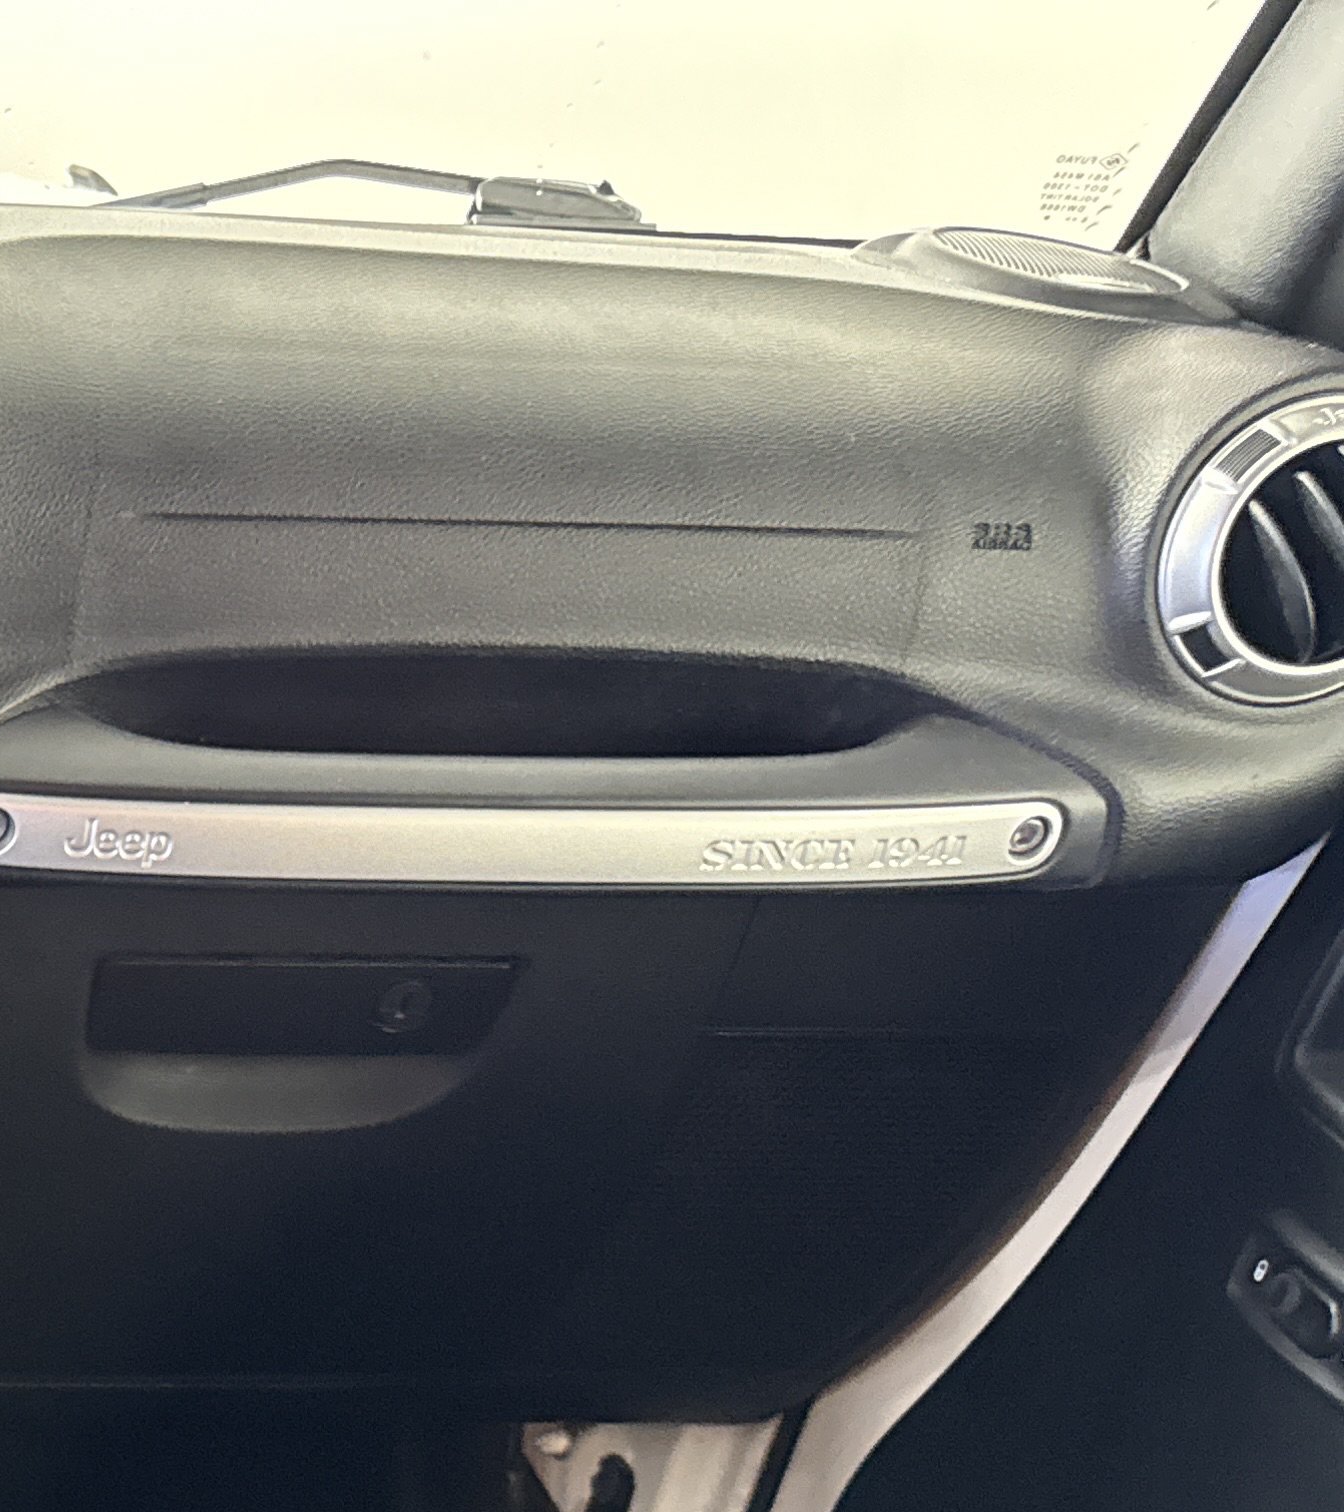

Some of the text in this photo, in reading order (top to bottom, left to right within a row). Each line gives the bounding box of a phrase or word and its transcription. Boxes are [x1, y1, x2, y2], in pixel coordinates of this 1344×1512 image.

[63, 817, 173, 869] Jeep
[699, 835, 967, 871] SINCE 1941
